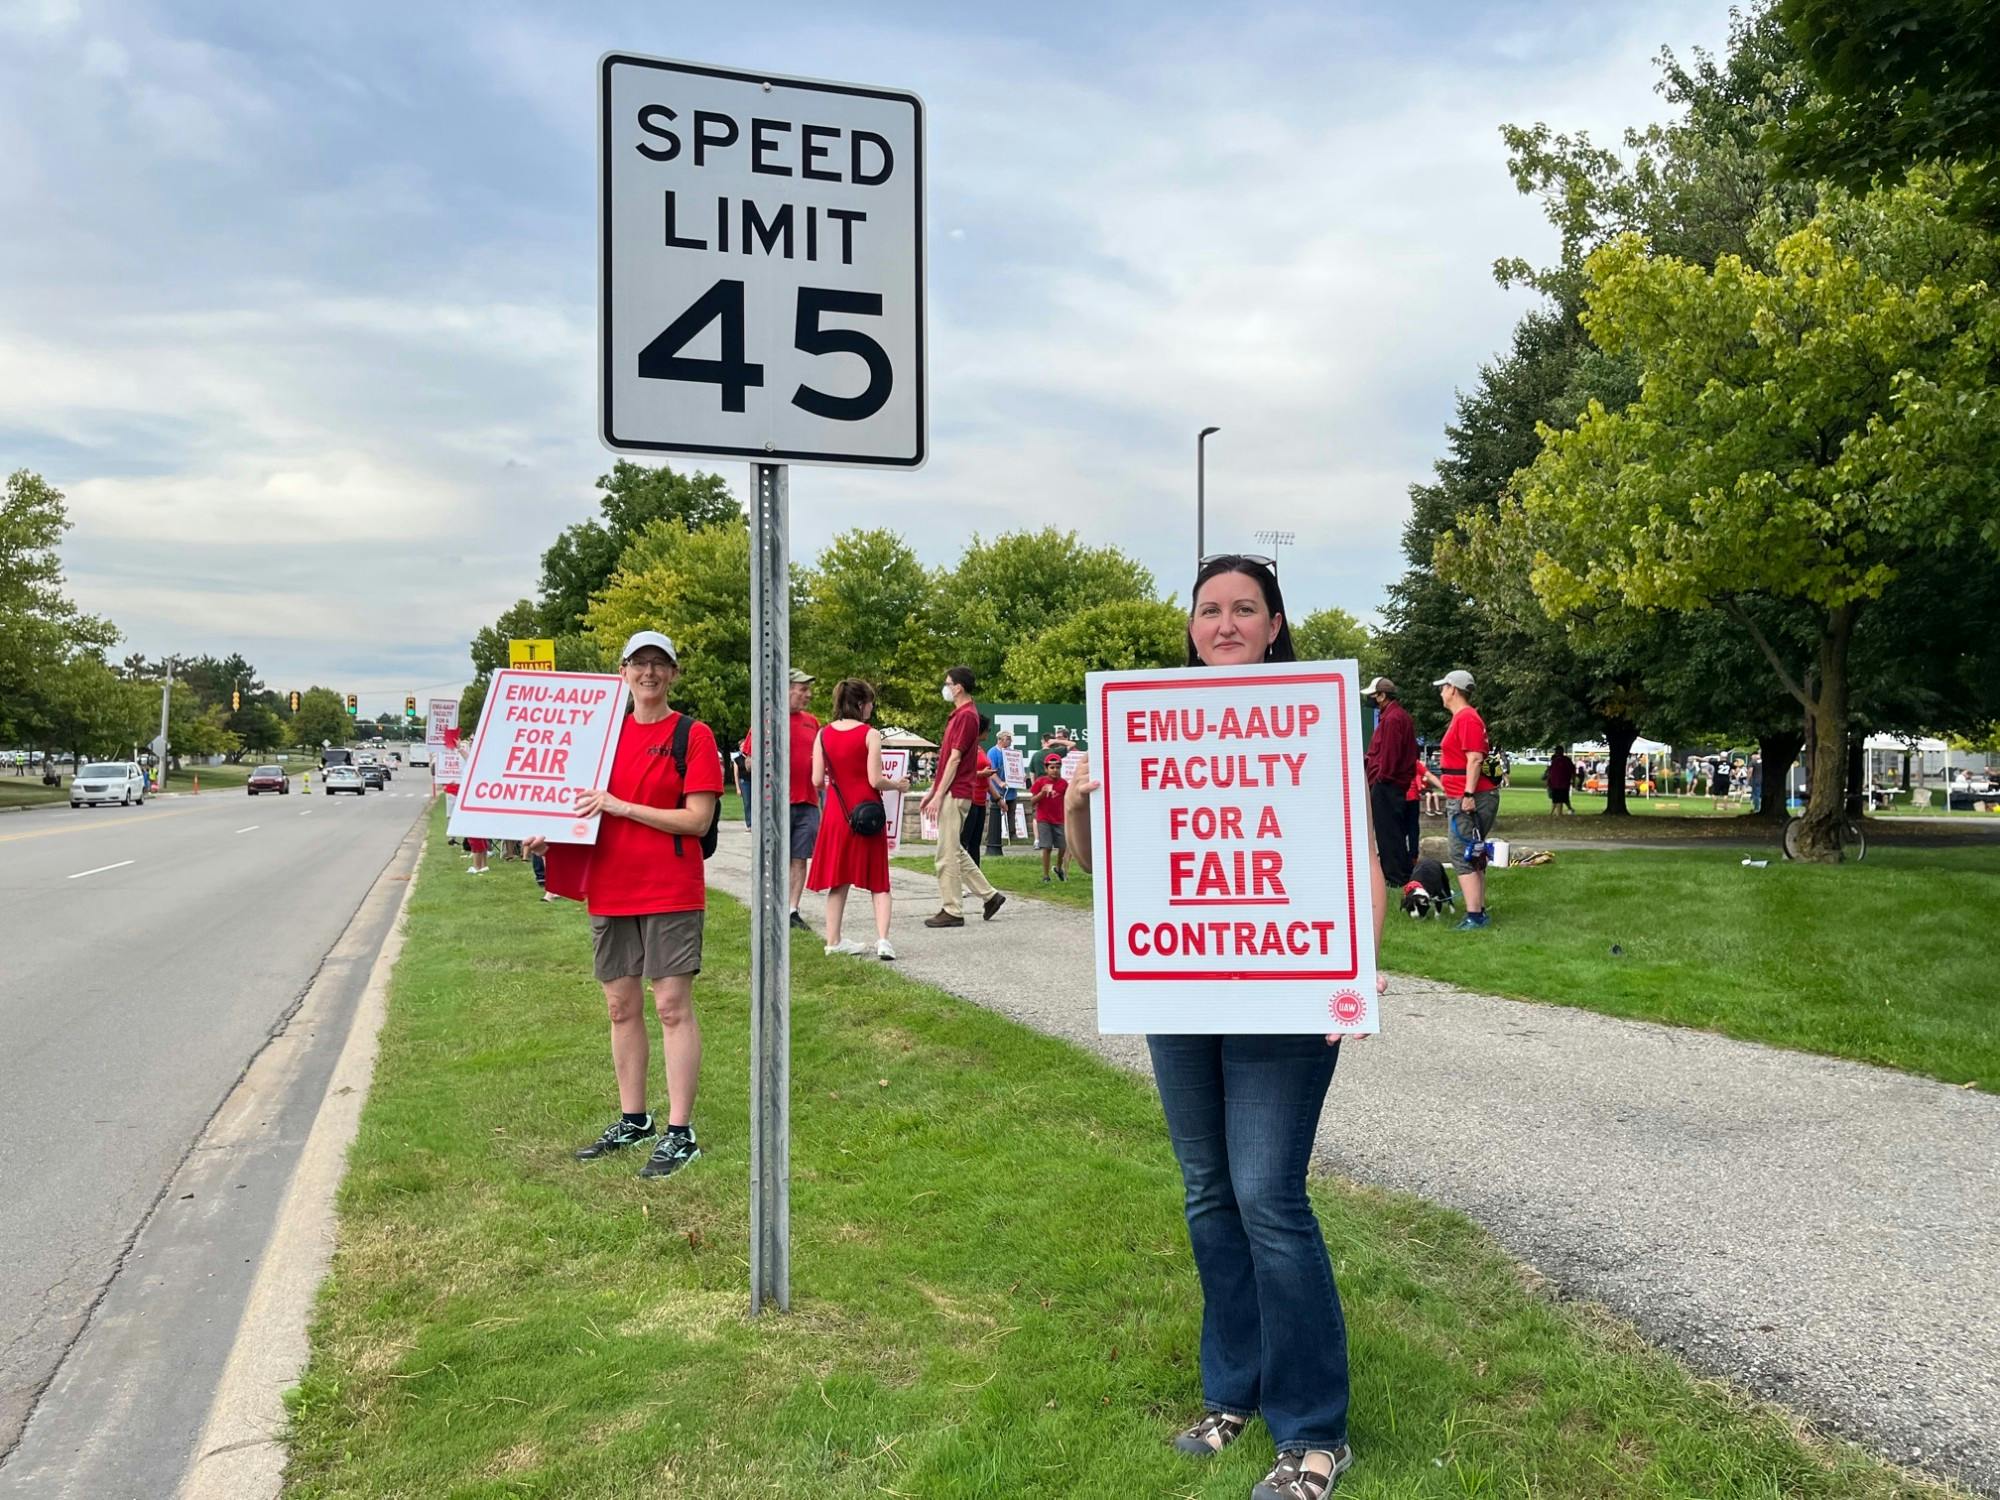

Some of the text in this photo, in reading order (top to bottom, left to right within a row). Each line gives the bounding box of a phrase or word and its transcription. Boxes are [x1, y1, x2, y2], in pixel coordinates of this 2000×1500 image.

[636, 104, 894, 186] SPEED
[665, 190, 867, 265] LIMIT
[638, 279, 893, 421] 45
[505, 684, 607, 705] EMU-AAUP
[505, 706, 595, 726] FACULTY
[1126, 704, 1320, 743] EMU-AAUP
[515, 728, 573, 746] FOR A
[505, 746, 569, 774] FAIR
[1140, 753, 1308, 790] FACULTY
[1717, 764, 1730, 775] 22
[1170, 806, 1282, 841] FOR A
[1169, 850, 1286, 896] FAIR
[1128, 921, 1335, 957] CONTRACT
